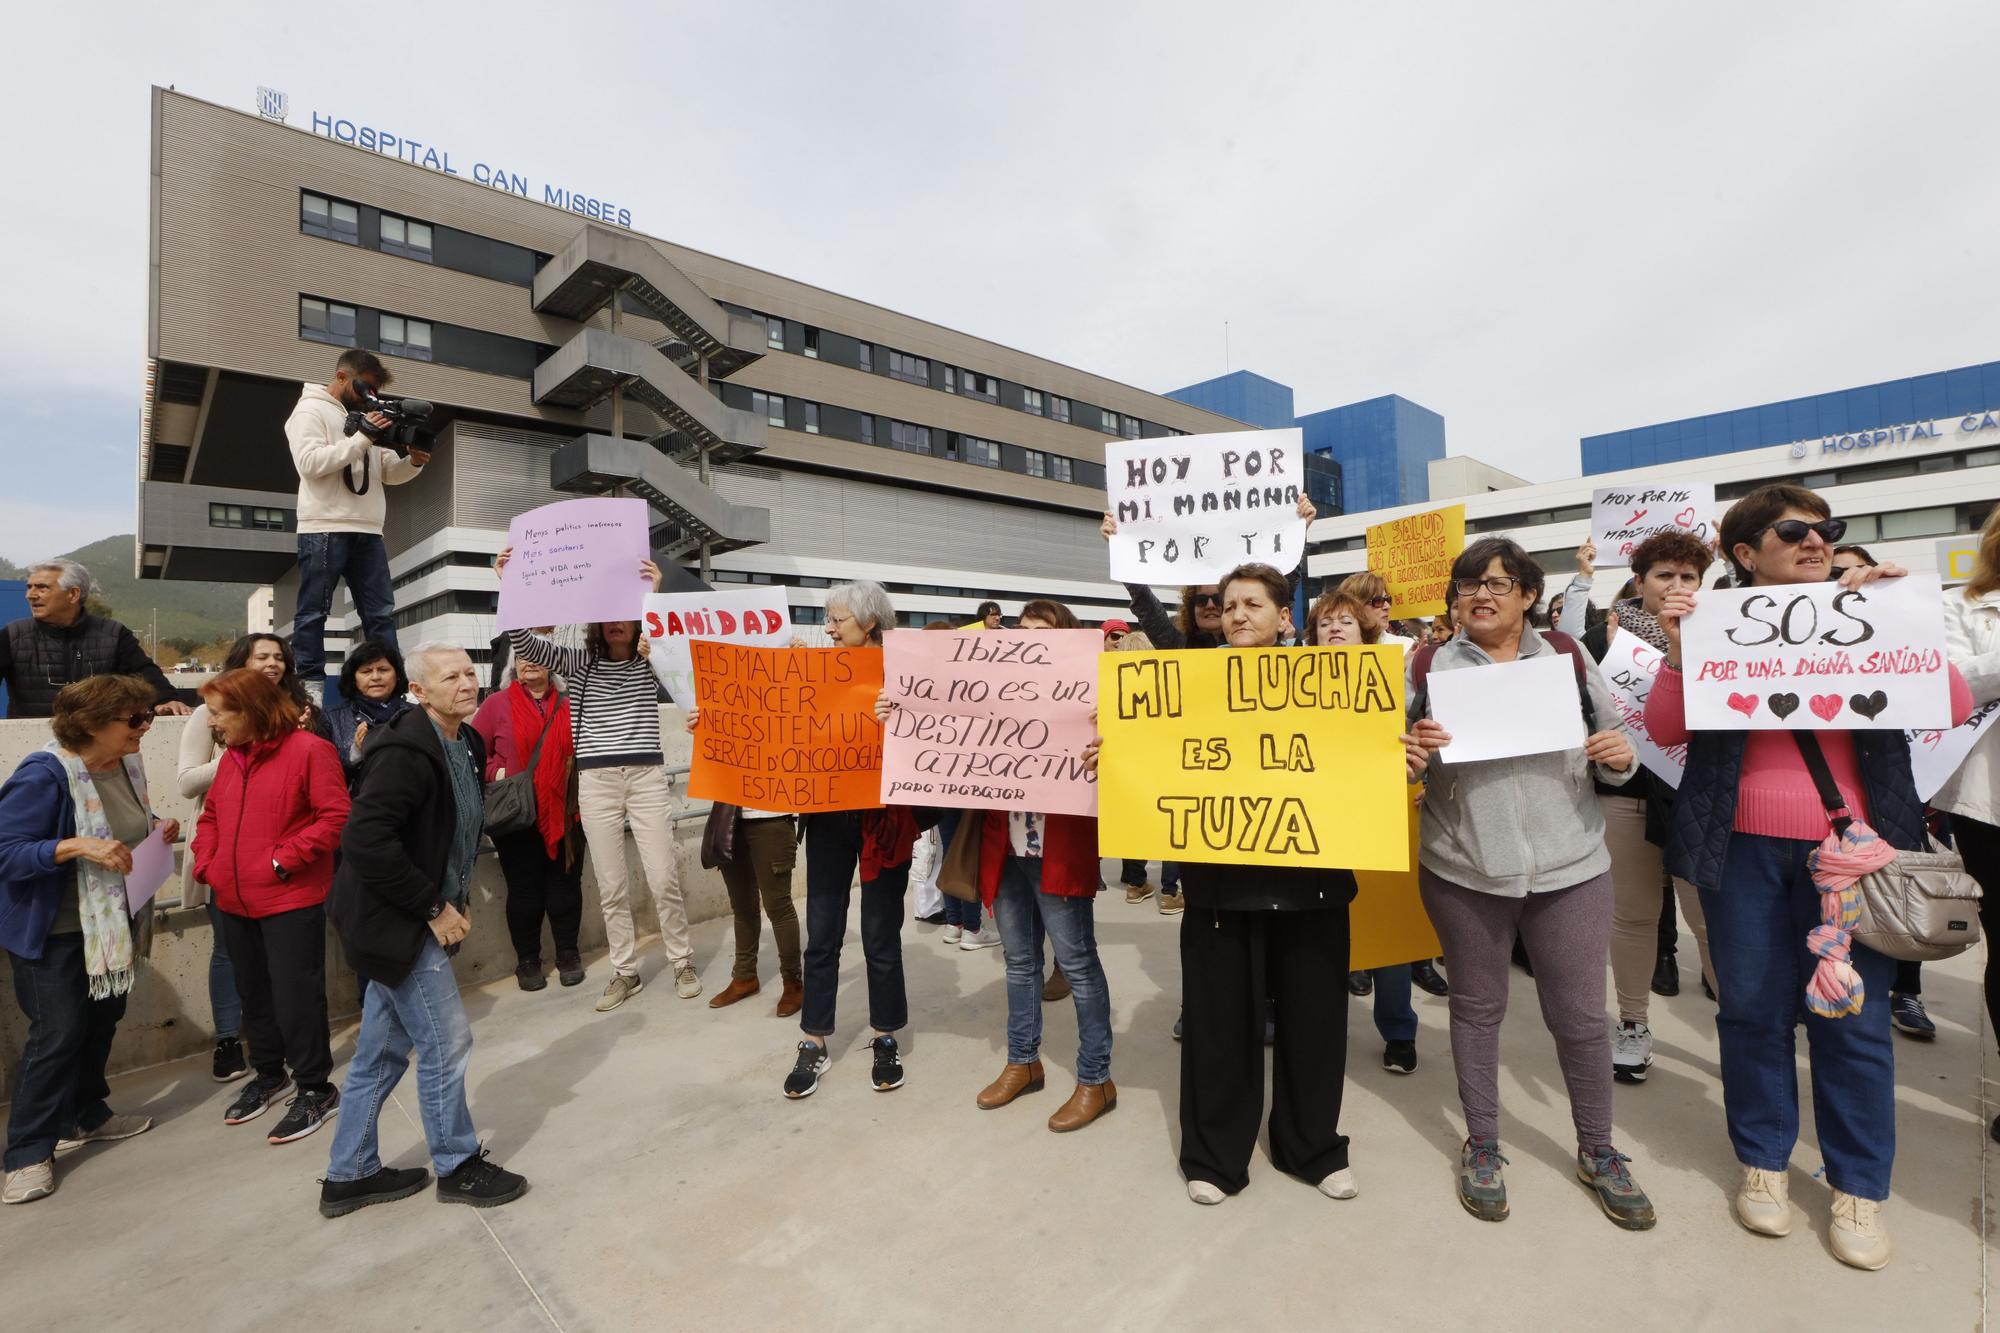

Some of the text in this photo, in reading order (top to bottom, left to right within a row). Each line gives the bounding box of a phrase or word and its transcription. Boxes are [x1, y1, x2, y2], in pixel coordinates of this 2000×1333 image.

[313, 111, 632, 228] HOSPITAL CAN MISSES
[1822, 422, 1943, 454] HOSPITAL
[1125, 448, 1285, 489] HOY POR
[1601, 493, 1636, 506] HOY
[1367, 513, 1443, 549] LA SALUD
[1625, 509, 1647, 526] Y
[1138, 532, 1282, 563] POR TI
[550, 564, 568, 572] VIDA
[696, 645, 853, 684] ELS MALALTS
[1632, 646, 1661, 675] CO
[1696, 660, 1738, 682] POR
[1746, 656, 1786, 680] UNA
[702, 677, 720, 703] DE
[898, 675, 1091, 703] ya no es un
[1118, 651, 1396, 720] MI LUCHA
[1611, 670, 1643, 692] DE
[703, 707, 880, 745] NECESSITEM UN
[704, 738, 760, 771] SERVEI
[1182, 733, 1315, 772] ES LA
[743, 775, 841, 807] ESTABLE
[1157, 796, 1320, 855] TUYA
